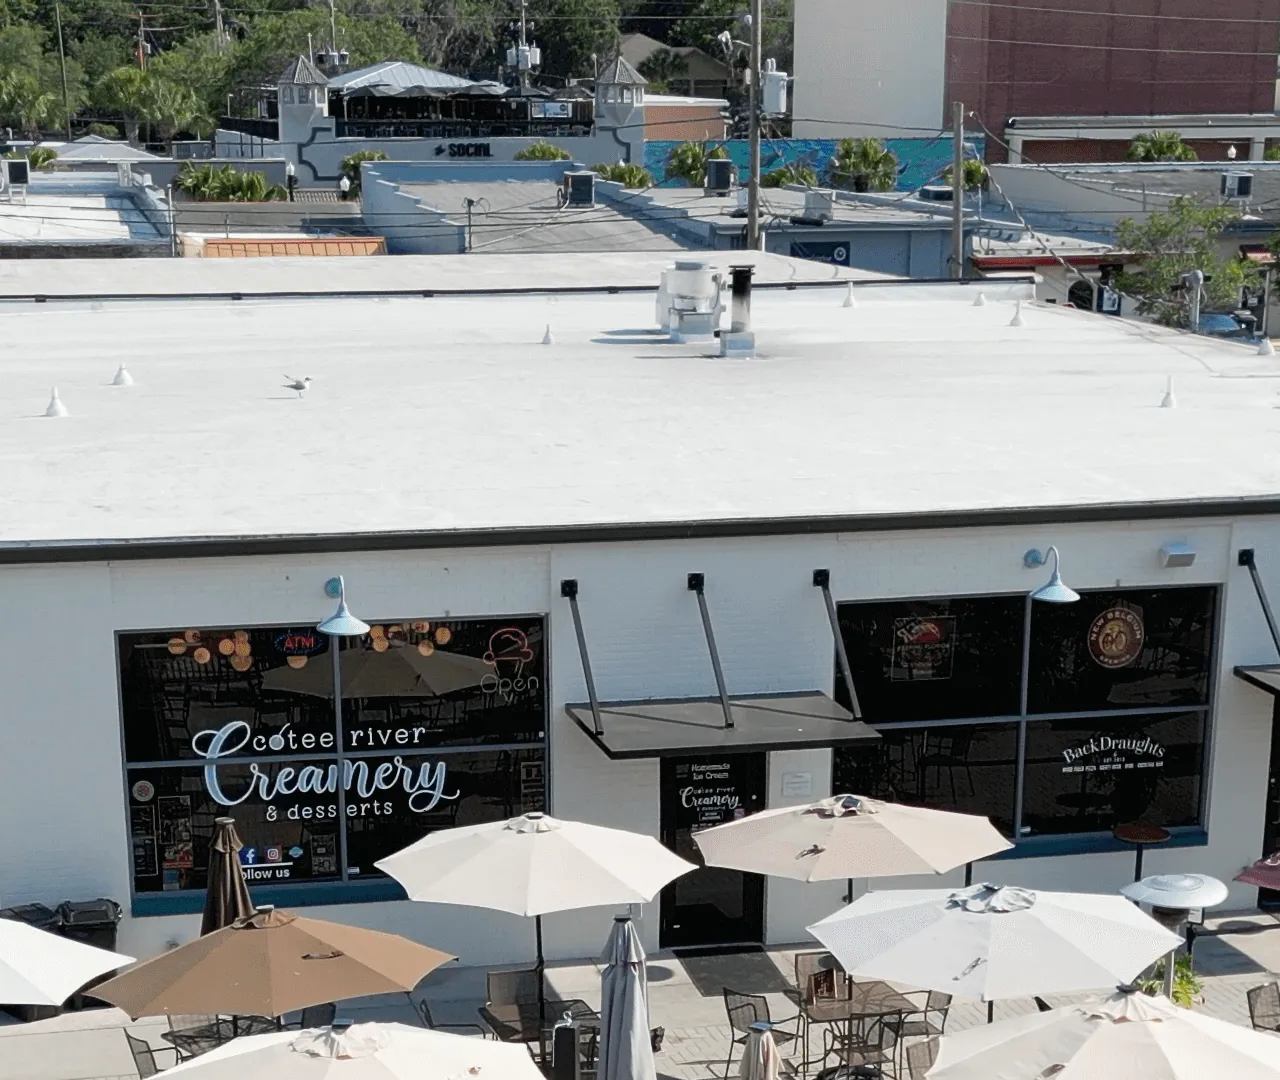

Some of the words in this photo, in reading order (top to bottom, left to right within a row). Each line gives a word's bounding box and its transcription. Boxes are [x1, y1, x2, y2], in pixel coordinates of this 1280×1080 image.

[448, 143, 494, 157] SOCIAL
[1090, 618, 1104, 640] NEW
[1107, 611, 1141, 639] BELGIUM
[284, 636, 315, 649] ATM
[481, 674, 539, 695] Open
[253, 723, 334, 750] cotee
[350, 727, 426, 747] river
[192, 720, 460, 813] Creamery
[691, 763, 731, 772] Homemade
[705, 771, 729, 779] Cream
[679, 787, 742, 809] Creamery
[266, 806, 277, 821] &
[287, 799, 394, 819] desserts
[241, 868, 272, 880] ollow
[276, 868, 290, 878] us
